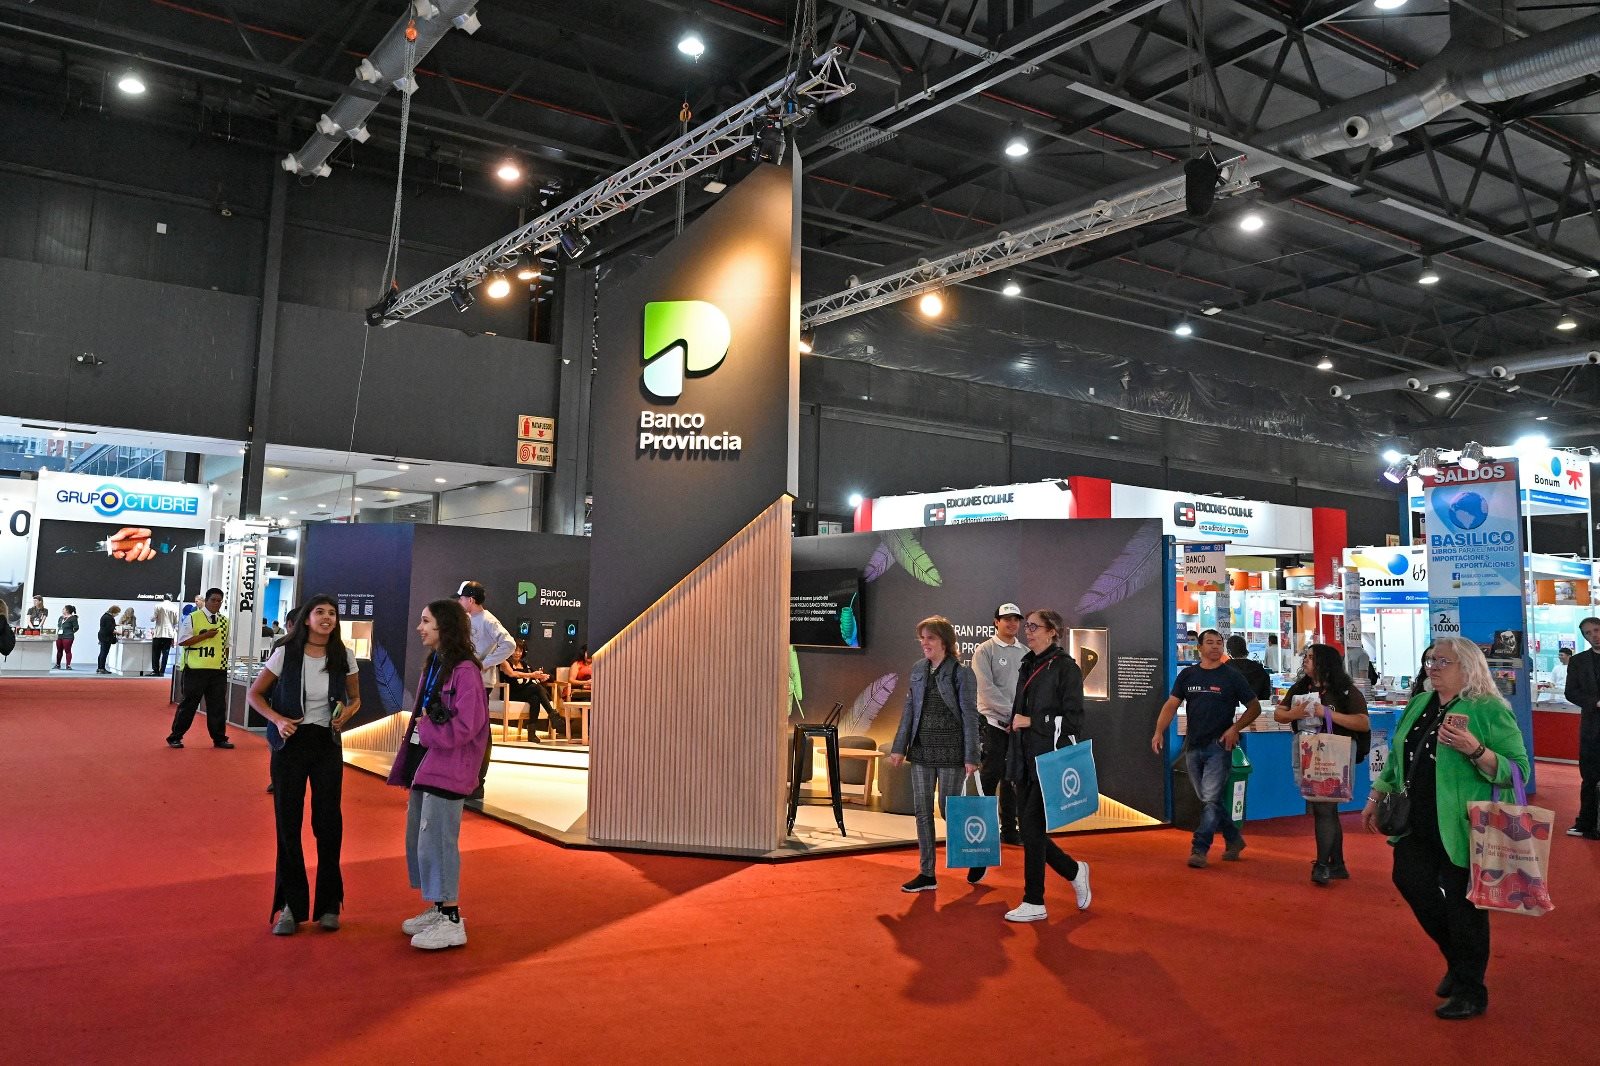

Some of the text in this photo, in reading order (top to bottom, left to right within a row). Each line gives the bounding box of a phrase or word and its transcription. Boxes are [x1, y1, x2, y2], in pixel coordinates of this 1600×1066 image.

[640, 411, 705, 428] Banco
[640, 431, 742, 450] Provincia
[1434, 465, 1505, 483] SALDOS
[1534, 474, 1561, 488] Bonum
[946, 496, 982, 508] EDICIONES
[1196, 502, 1227, 515] EDICIONES
[1431, 531, 1515, 547] BASILICO
[1186, 555, 1206, 564] BANCO
[1432, 554, 1490, 562] IMPORTACIONES
[1186, 565, 1217, 574] PROVINCIA
[1455, 560, 1515, 569] EXPORTACIONES
[1359, 577, 1405, 587] Bonum
[540, 588, 567, 598] Banco
[540, 597, 581, 608] Provincia
[1440, 614, 1451, 623] 2x
[952, 626, 974, 637] RAN
[199, 646, 215, 657] 114
